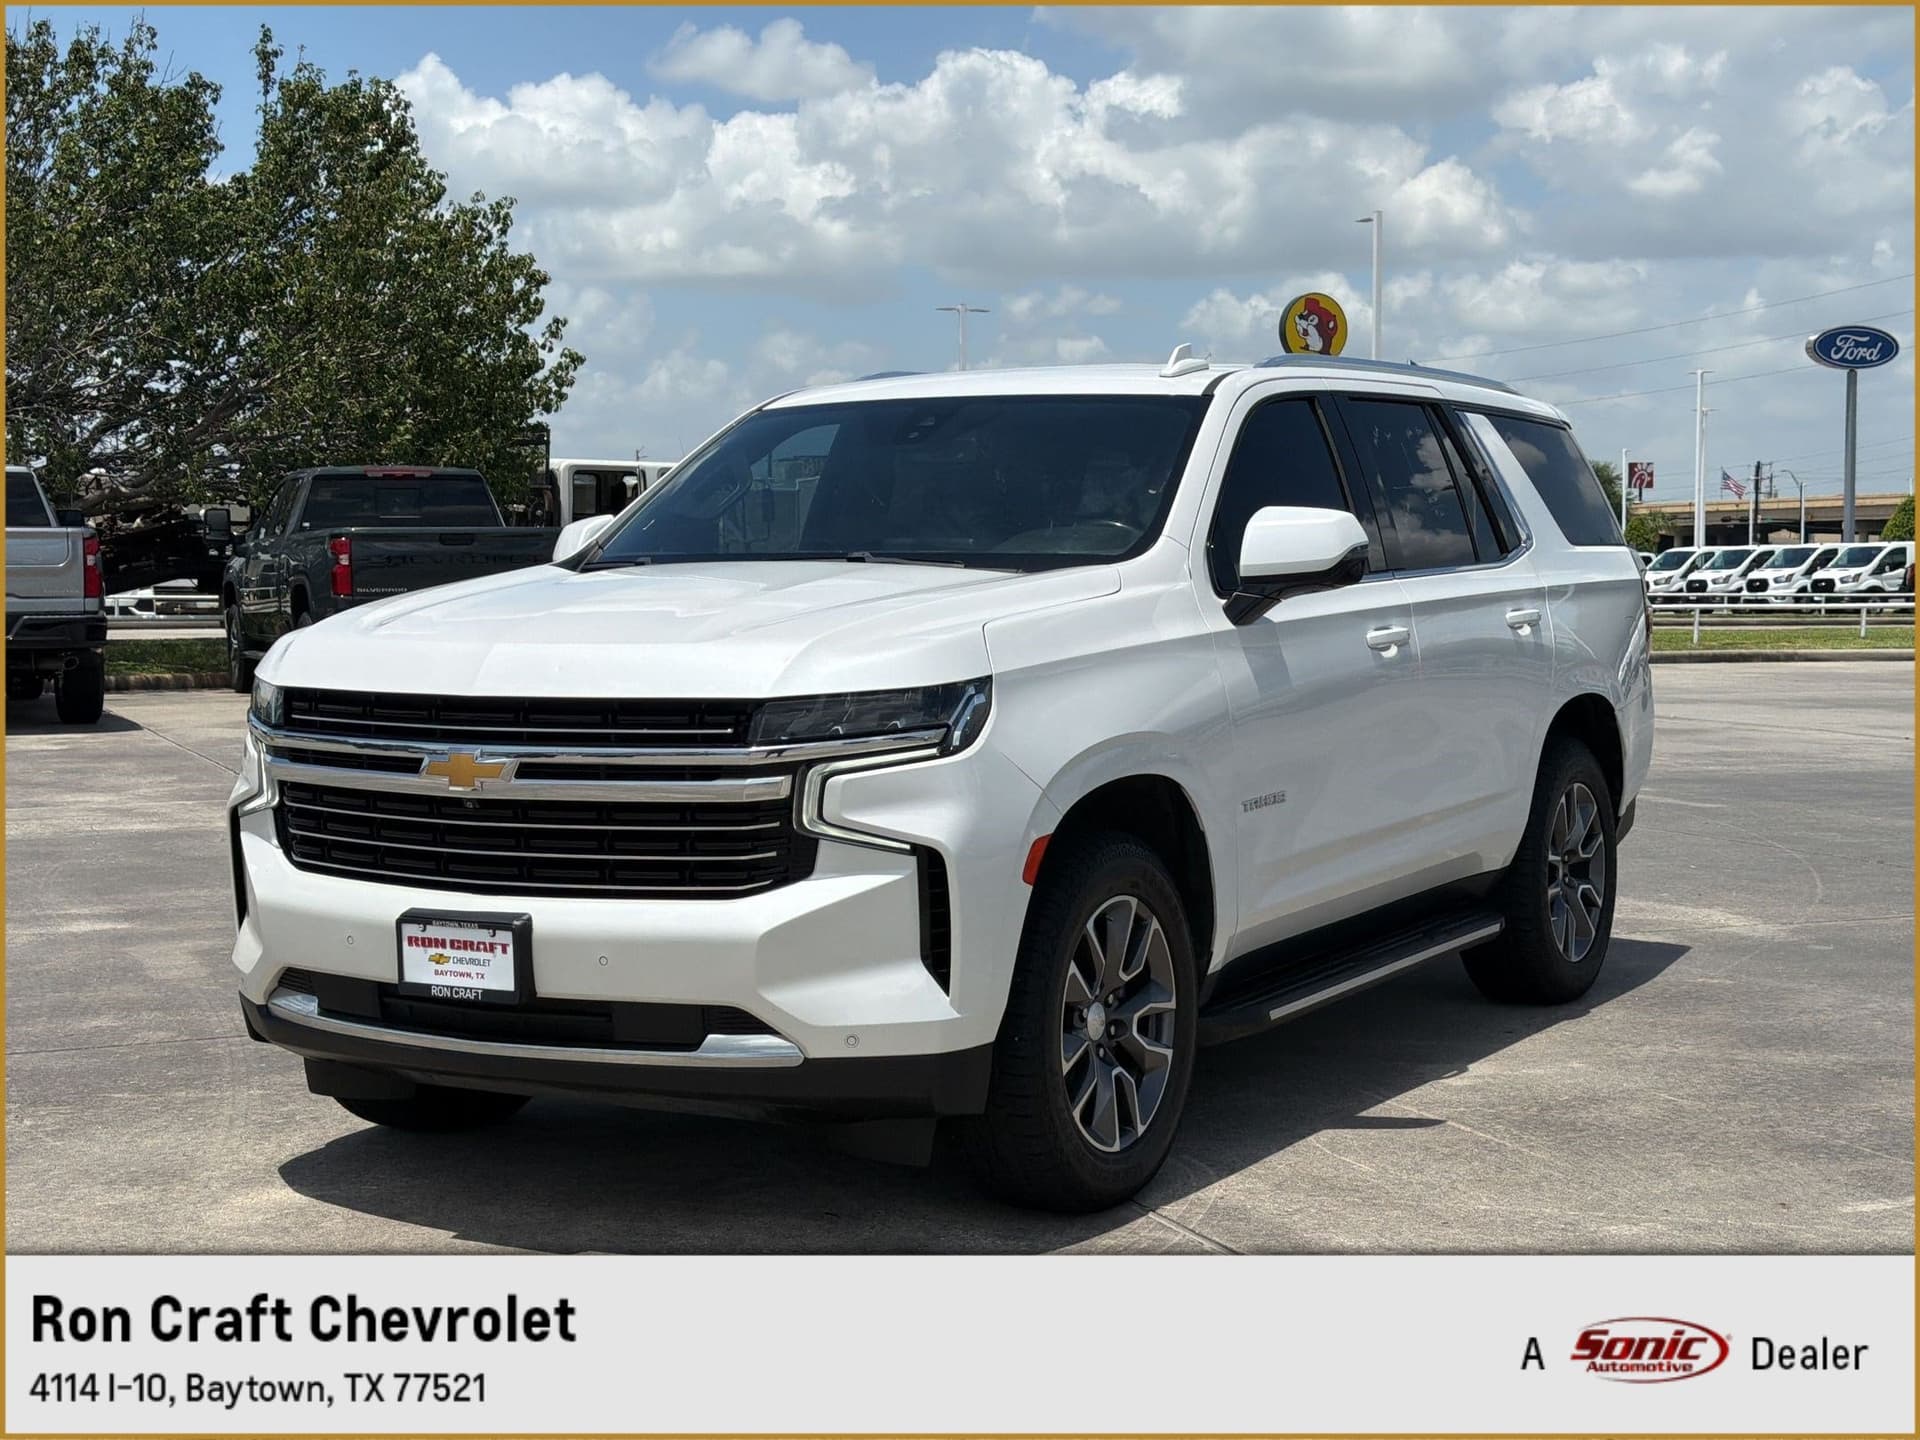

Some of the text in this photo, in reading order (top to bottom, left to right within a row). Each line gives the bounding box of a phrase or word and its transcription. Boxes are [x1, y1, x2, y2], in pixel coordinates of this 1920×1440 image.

[1831, 334, 1882, 361] Ford
[407, 935, 510, 955] RON CRAFT
[452, 955, 491, 967] CHEVROLET
[434, 969, 474, 980] BAYTOWN,
[431, 985, 483, 1000] RON CRAFT
